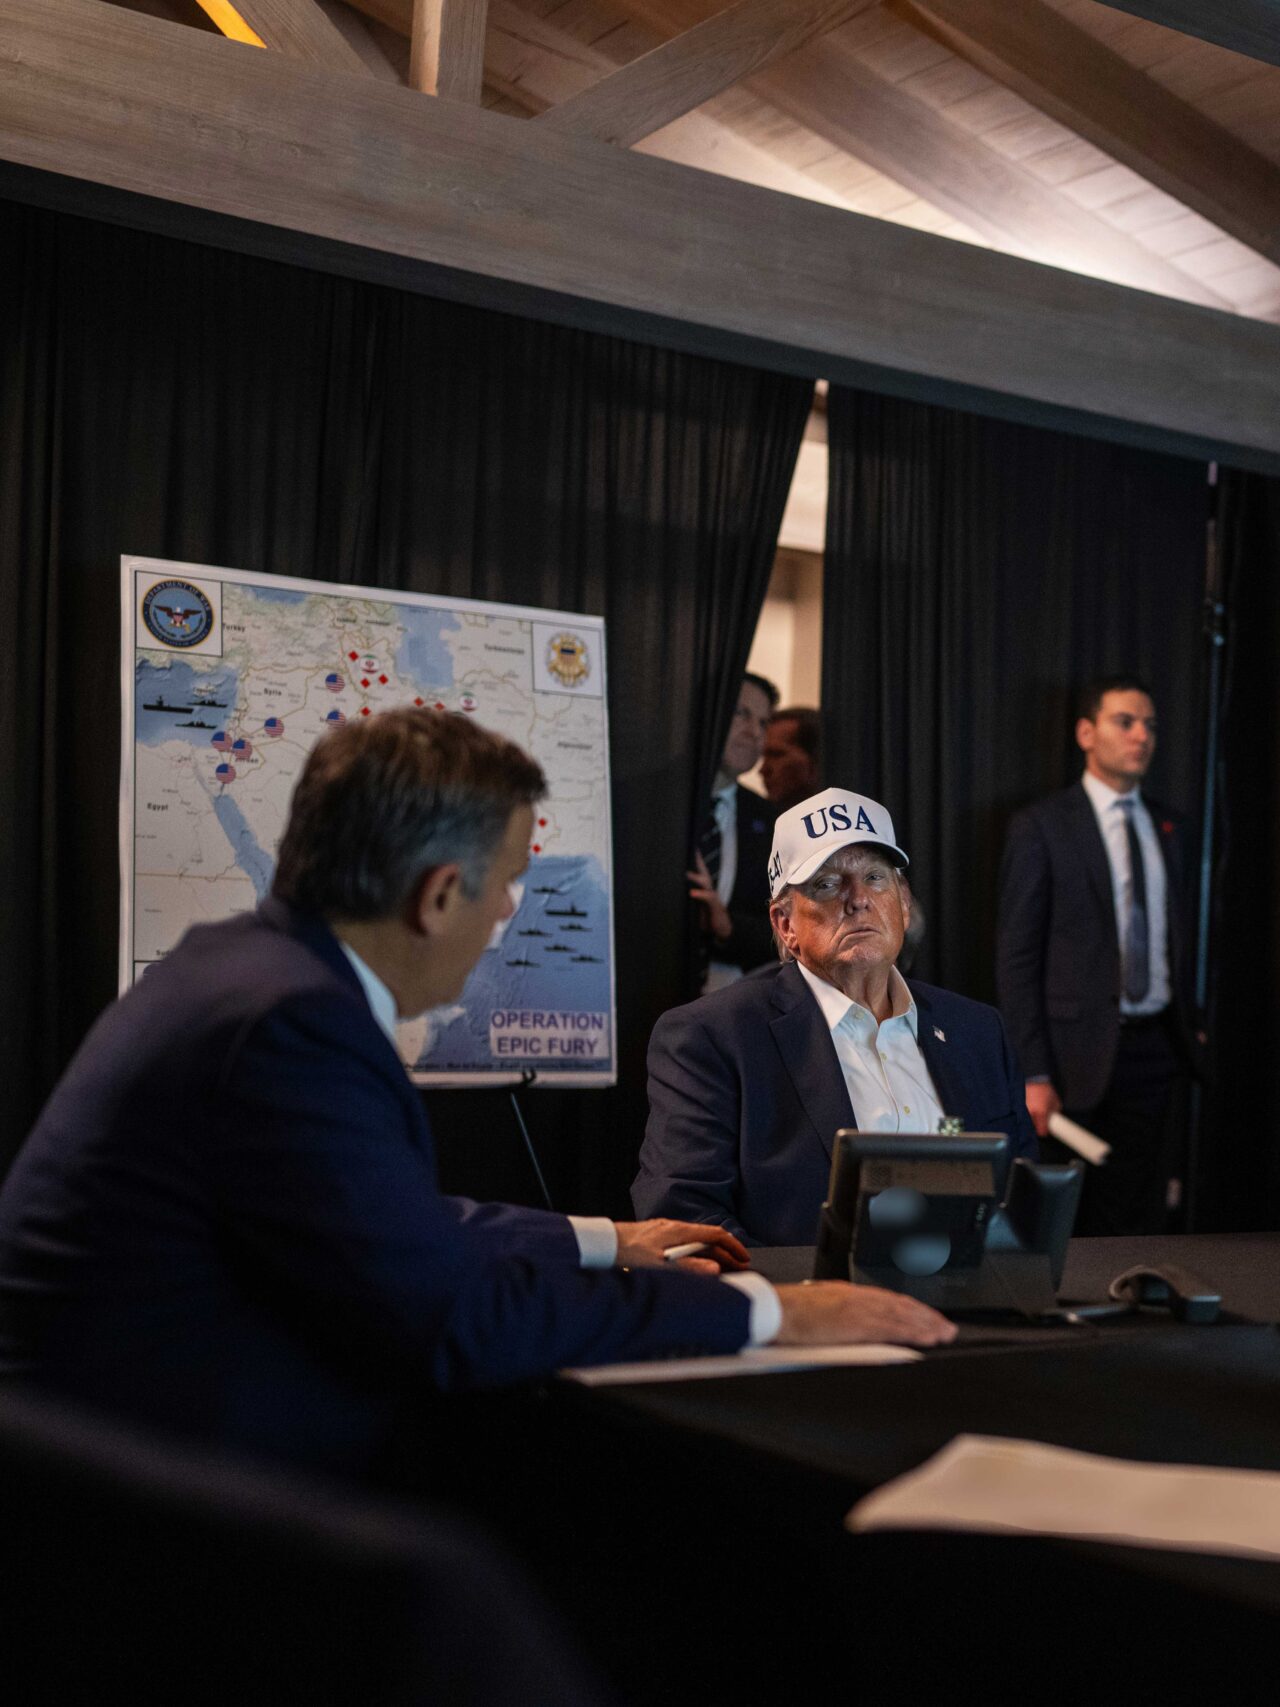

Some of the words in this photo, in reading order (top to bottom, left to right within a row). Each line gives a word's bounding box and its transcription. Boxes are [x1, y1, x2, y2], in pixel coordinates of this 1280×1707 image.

[263, 687, 282, 697] Syria
[147, 802, 169, 812] Egypt
[801, 803, 878, 838] USA
[491, 1011, 604, 1030] OPERATION
[497, 1036, 541, 1054] EPIC
[548, 1037, 599, 1055] FURY
